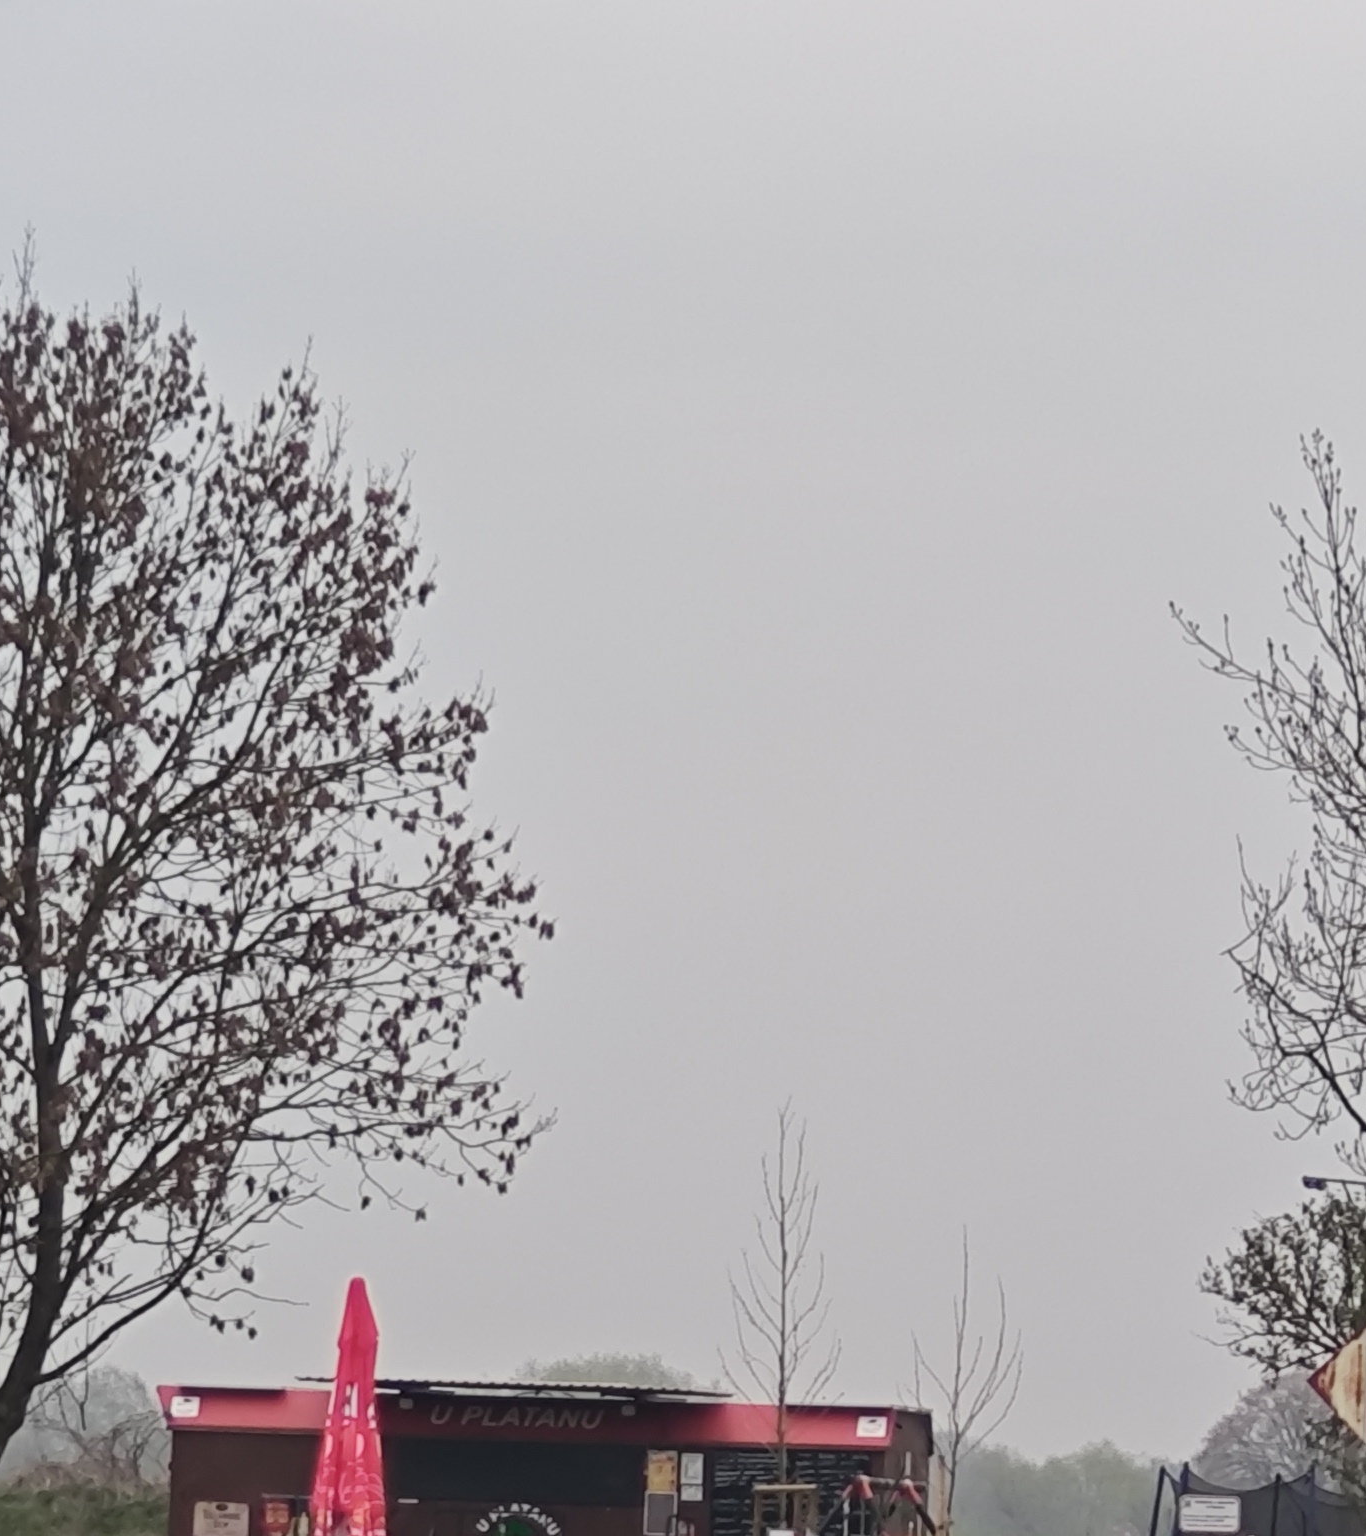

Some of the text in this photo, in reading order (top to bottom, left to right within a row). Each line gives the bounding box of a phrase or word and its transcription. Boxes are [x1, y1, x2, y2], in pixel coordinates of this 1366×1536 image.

[430, 1405, 604, 1430] U PLATANU
[475, 1518, 490, 1533] U
